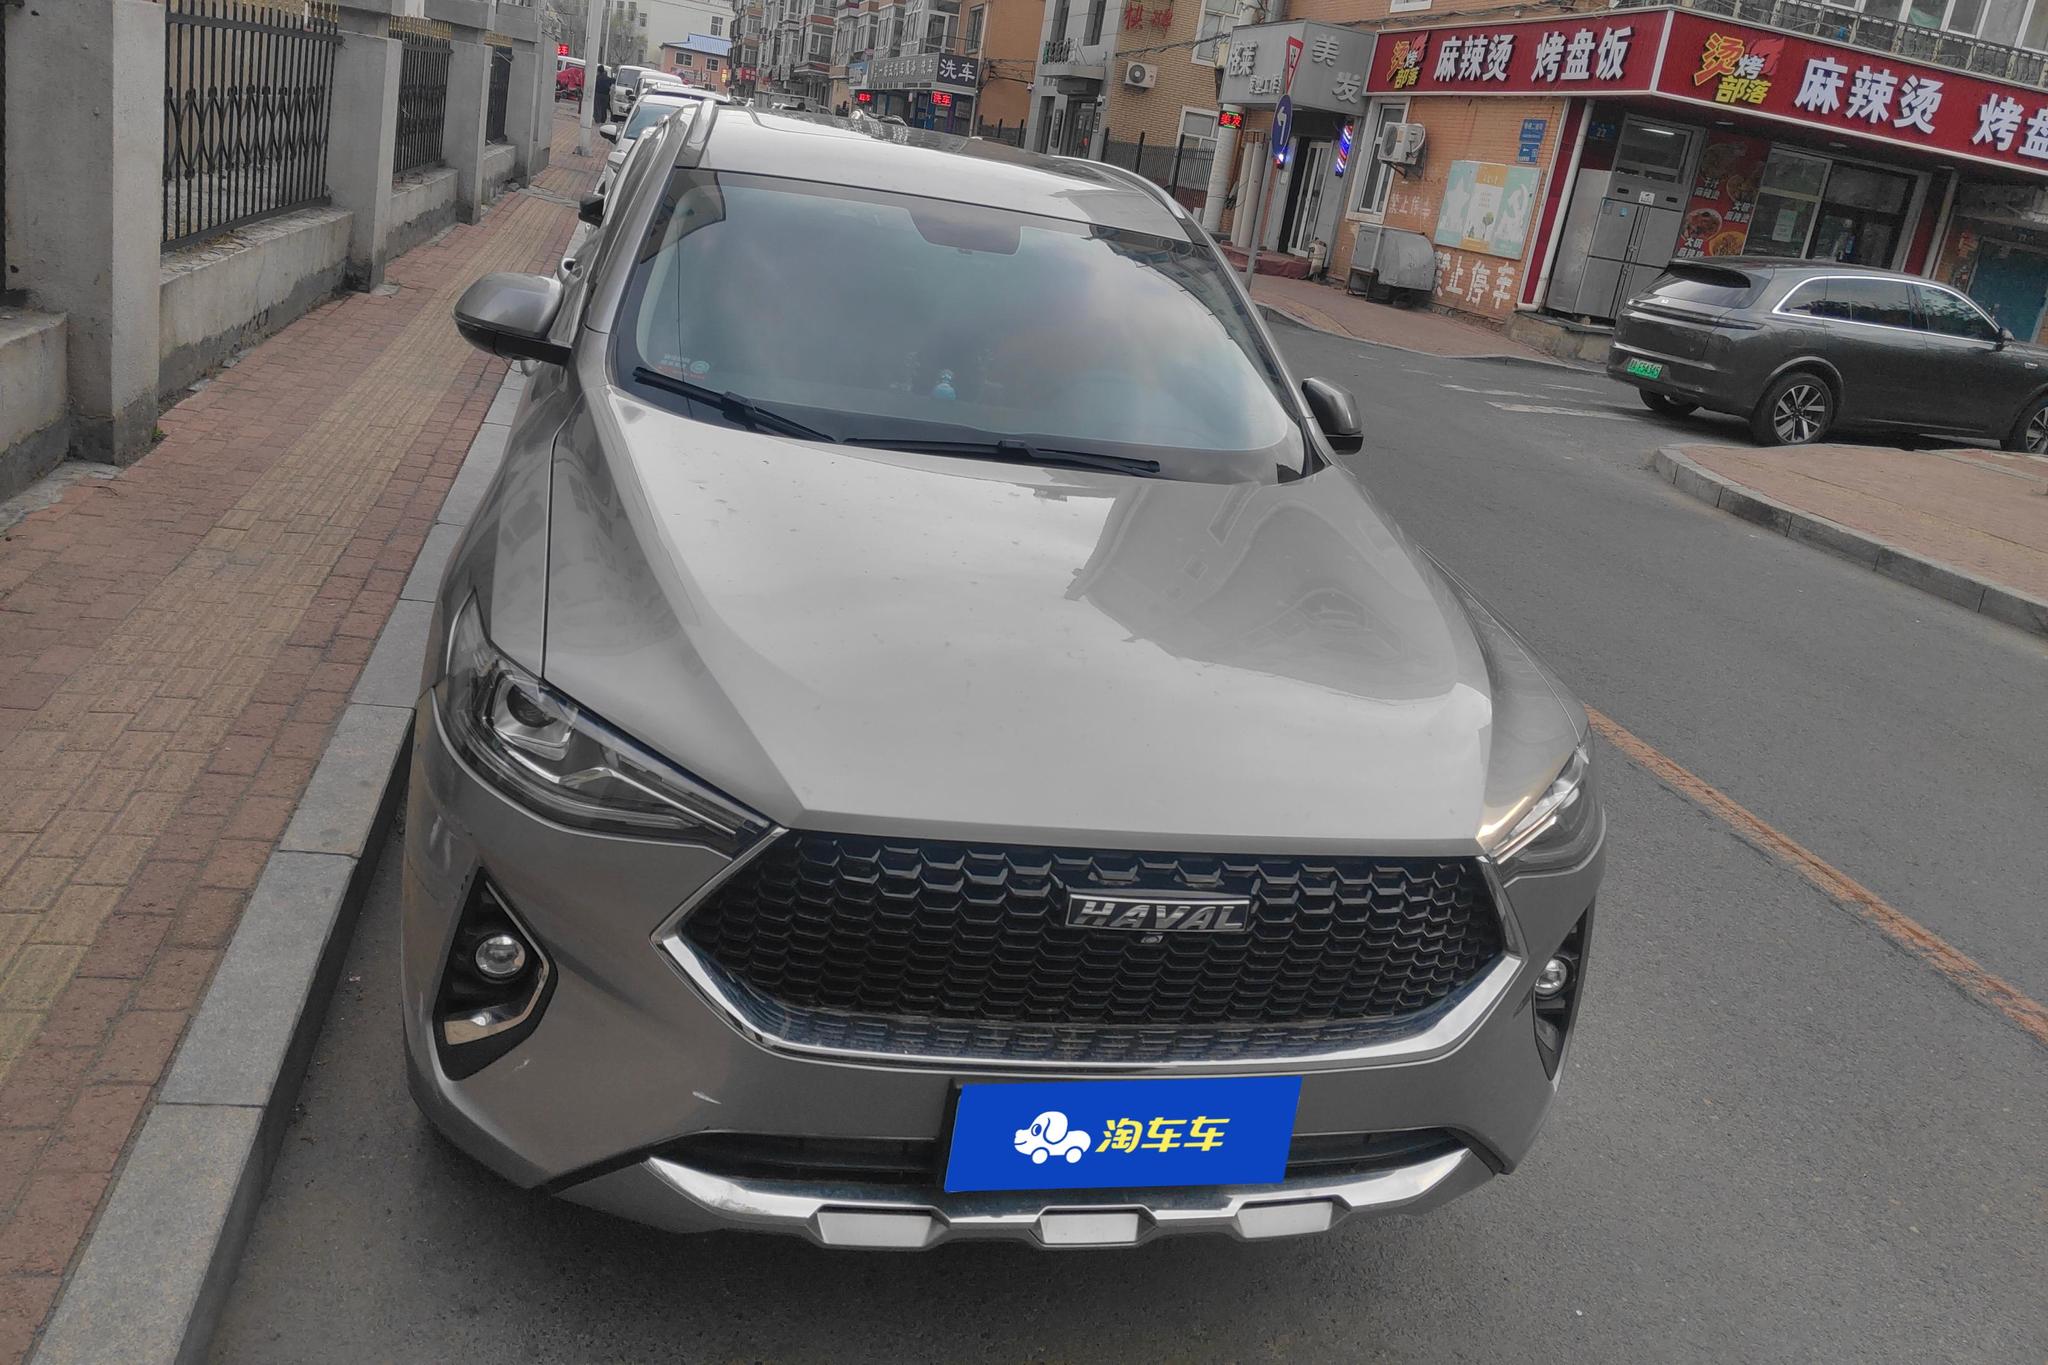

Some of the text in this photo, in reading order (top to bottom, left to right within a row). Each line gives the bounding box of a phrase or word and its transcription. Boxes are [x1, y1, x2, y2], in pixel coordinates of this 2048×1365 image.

[1434, 26, 1633, 82] 麻辣烫 烤盘饭
[940, 58, 976, 82] 洗车
[932, 92, 951, 106] 洗车
[1715, 75, 1772, 104] 部落
[1794, 57, 1944, 134] 麻辣烫
[1220, 112, 1242, 127] 美发
[1074, 901, 1242, 930] HAVAL
